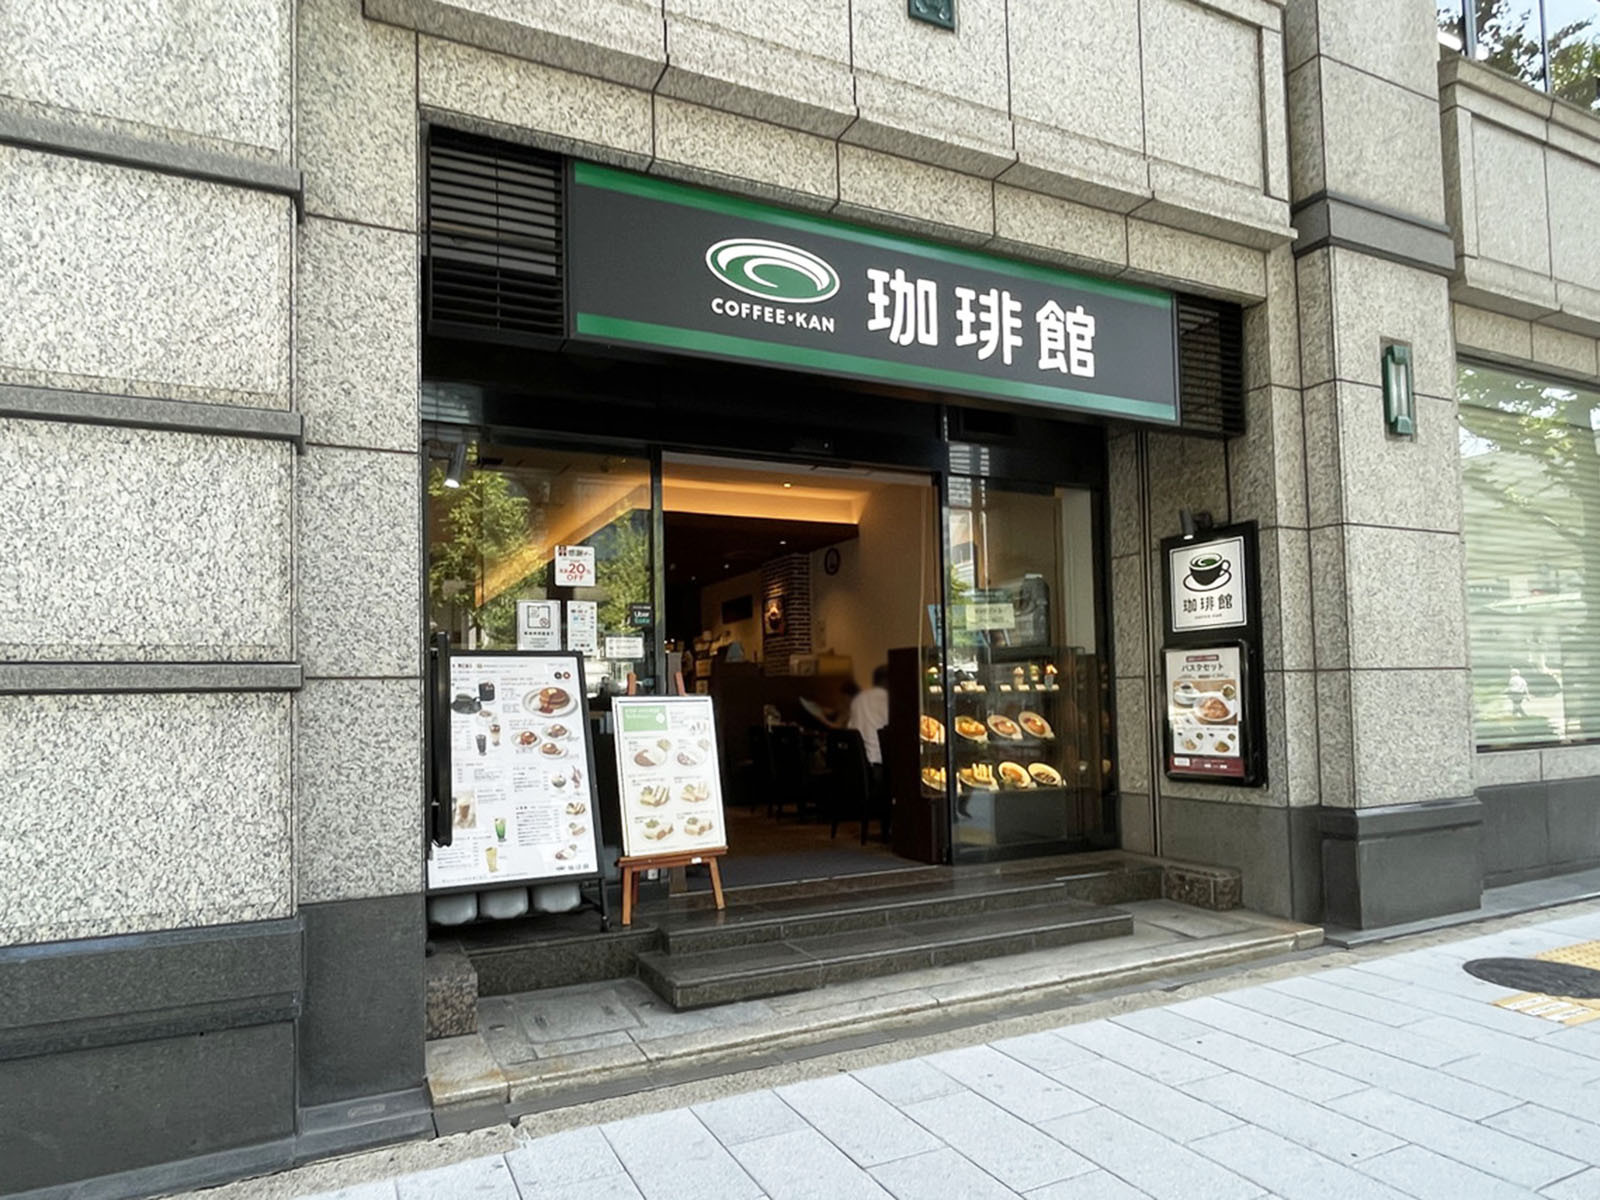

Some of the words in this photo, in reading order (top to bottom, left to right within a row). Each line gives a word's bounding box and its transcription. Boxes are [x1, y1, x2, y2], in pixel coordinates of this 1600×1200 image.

[868, 268, 1095, 378] 珈琲館
[1183, 593, 1232, 612] 珈琲館
